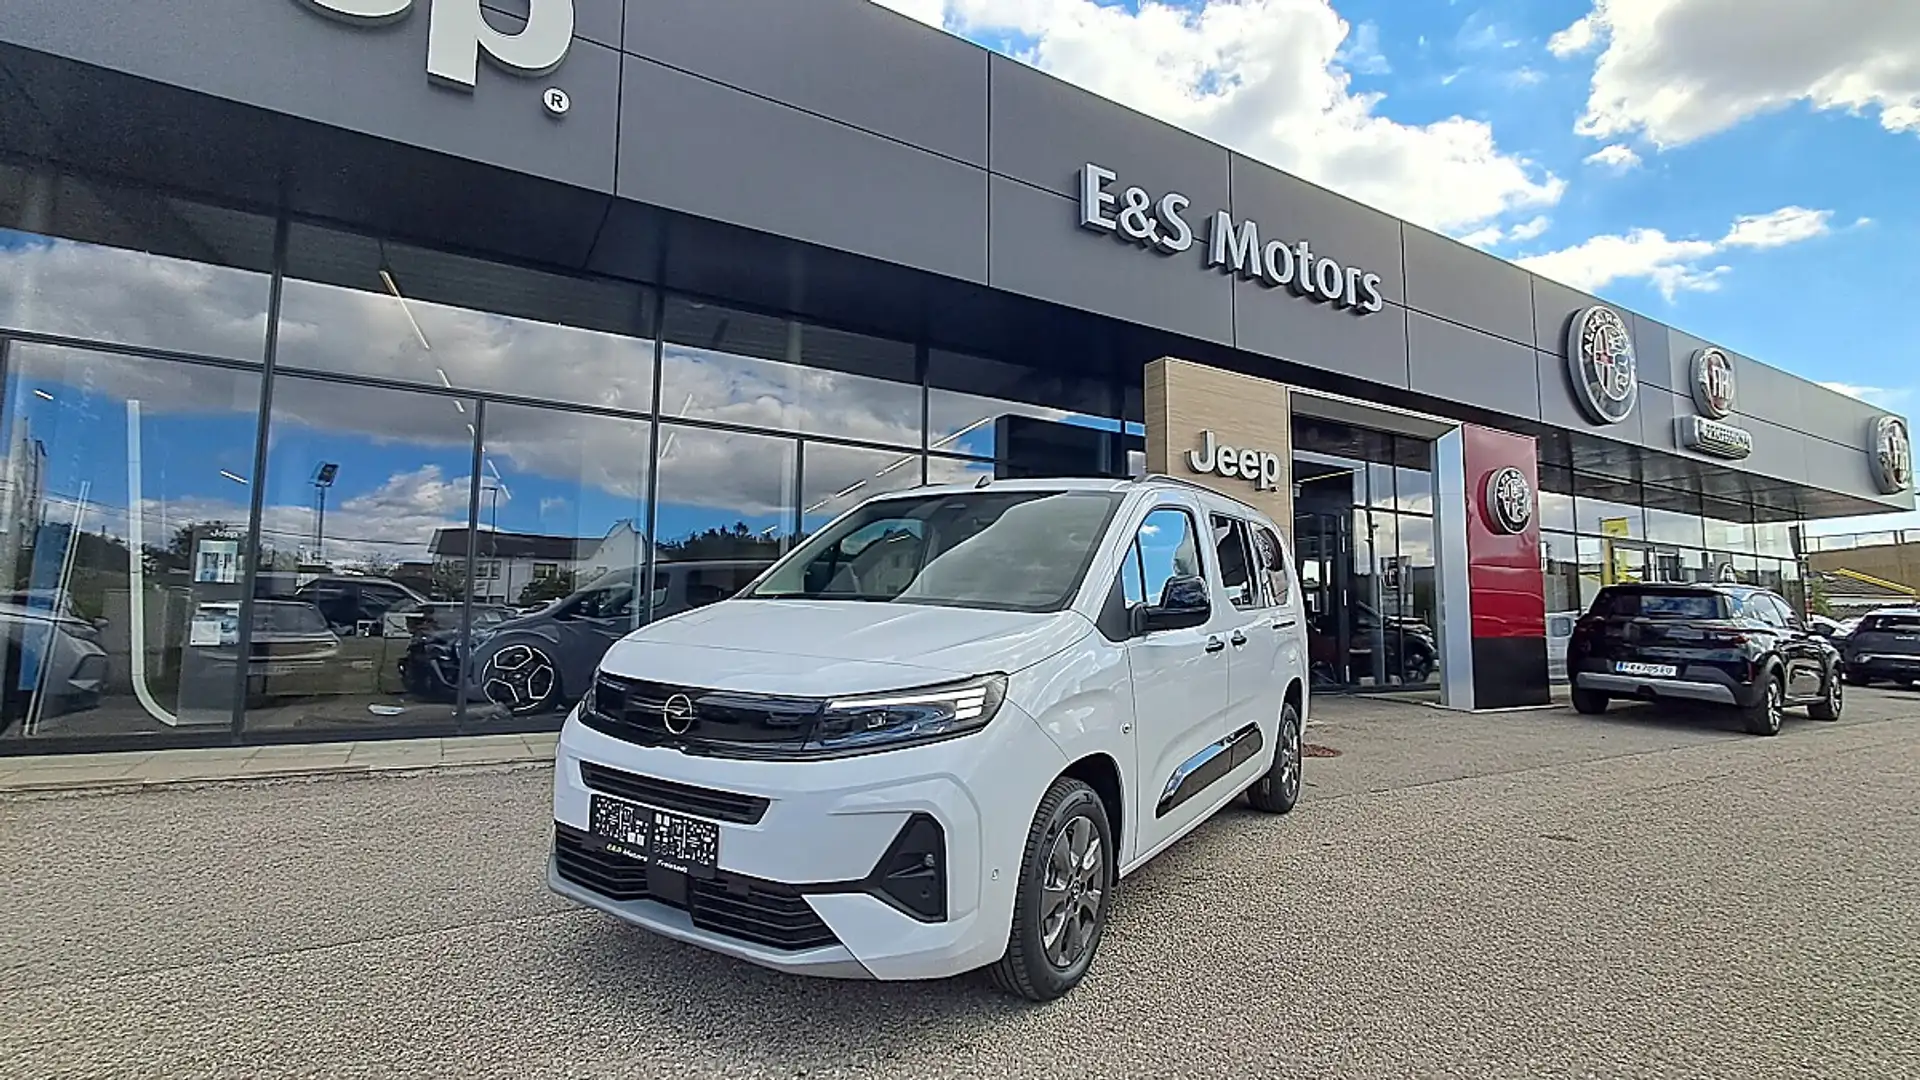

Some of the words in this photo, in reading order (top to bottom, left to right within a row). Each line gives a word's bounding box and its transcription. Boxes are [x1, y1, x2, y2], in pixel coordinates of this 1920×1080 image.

[1080, 163, 1194, 253] E&S
[1208, 211, 1383, 313] Motors
[1184, 429, 1281, 490] Jeep
